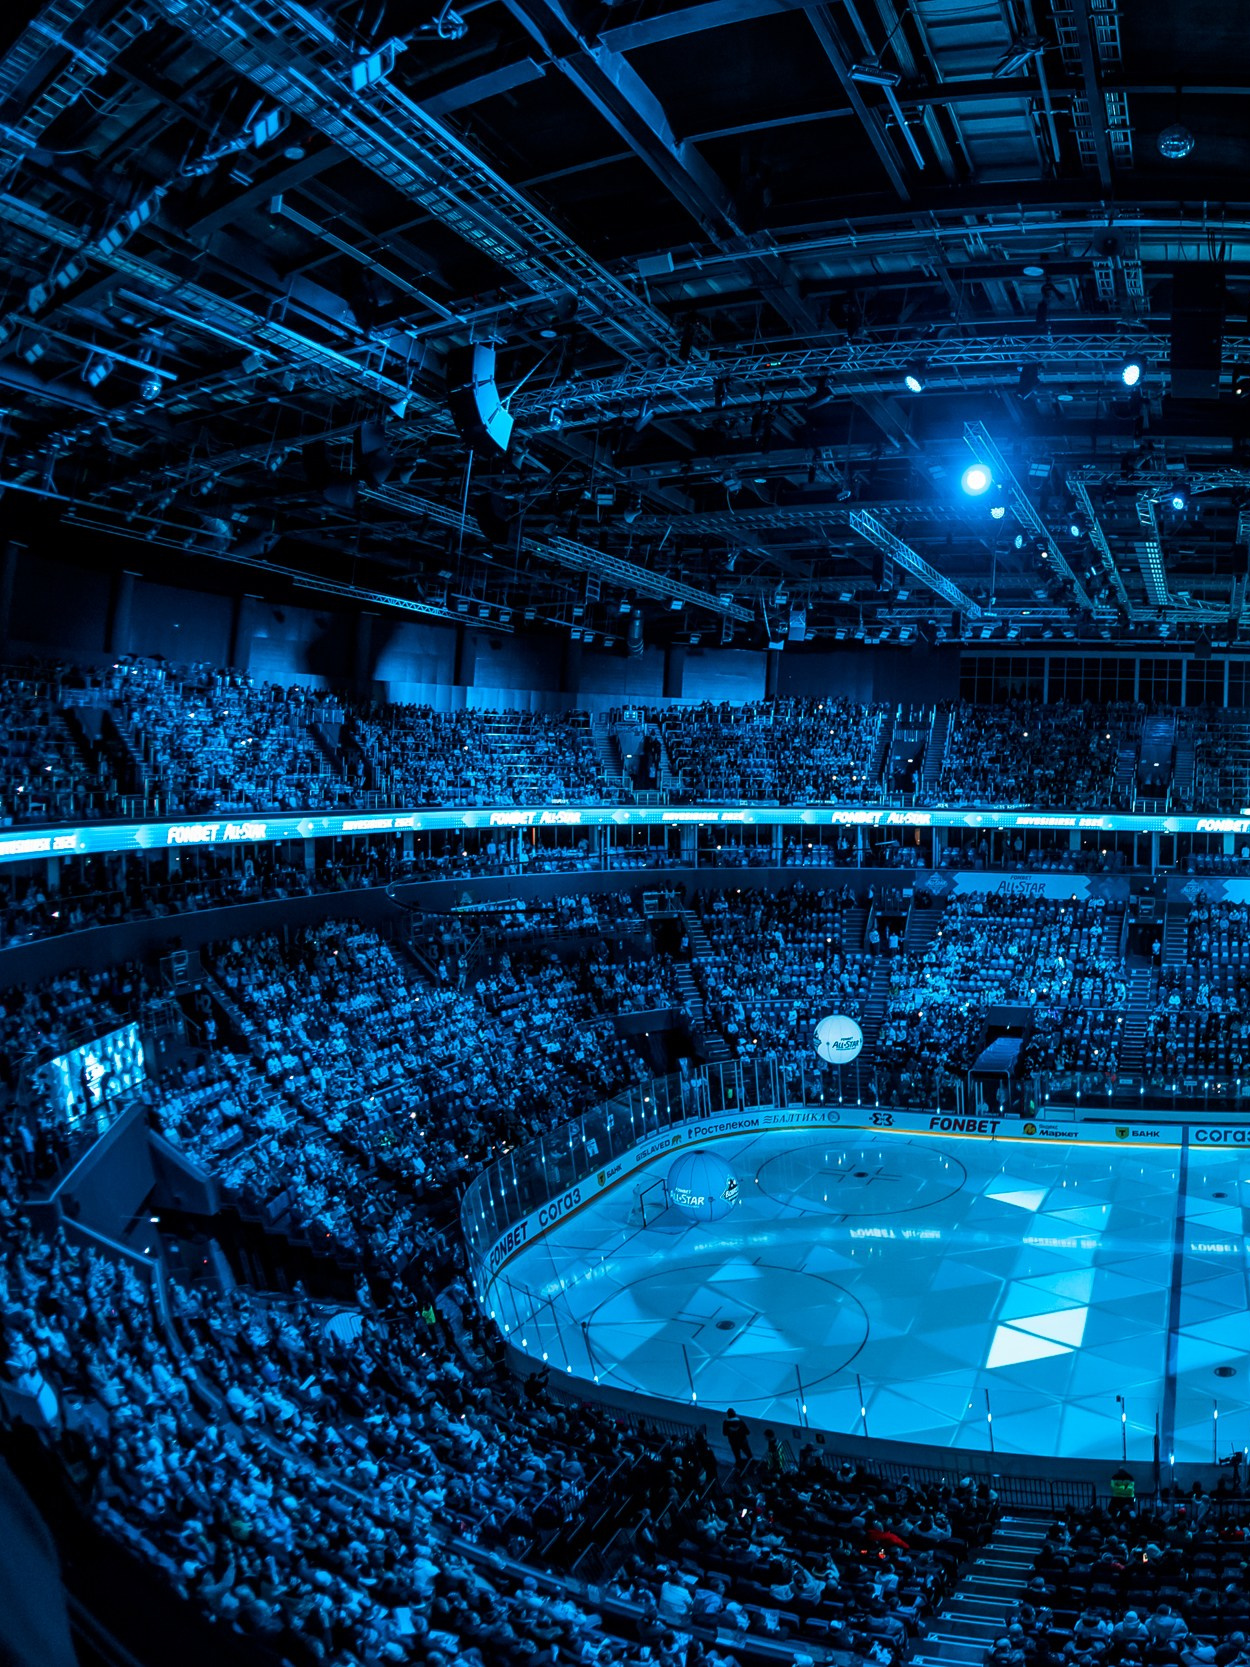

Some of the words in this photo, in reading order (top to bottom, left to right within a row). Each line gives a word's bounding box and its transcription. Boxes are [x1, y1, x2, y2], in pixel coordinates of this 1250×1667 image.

[489, 811, 537, 825] FONBET
[831, 811, 882, 824] FONBET
[1195, 820, 1250, 832] FONBET
[167, 825, 219, 844] FONBET
[773, 1112, 826, 1124] БАЛТИКА
[930, 1117, 1001, 1134] FONBET
[694, 1118, 759, 1137] Ростелеком
[1039, 1130, 1079, 1138] Маркет
[636, 1140, 670, 1162] GISLAVED
[606, 1164, 623, 1179] БАНК
[489, 1221, 528, 1273] FONBET
